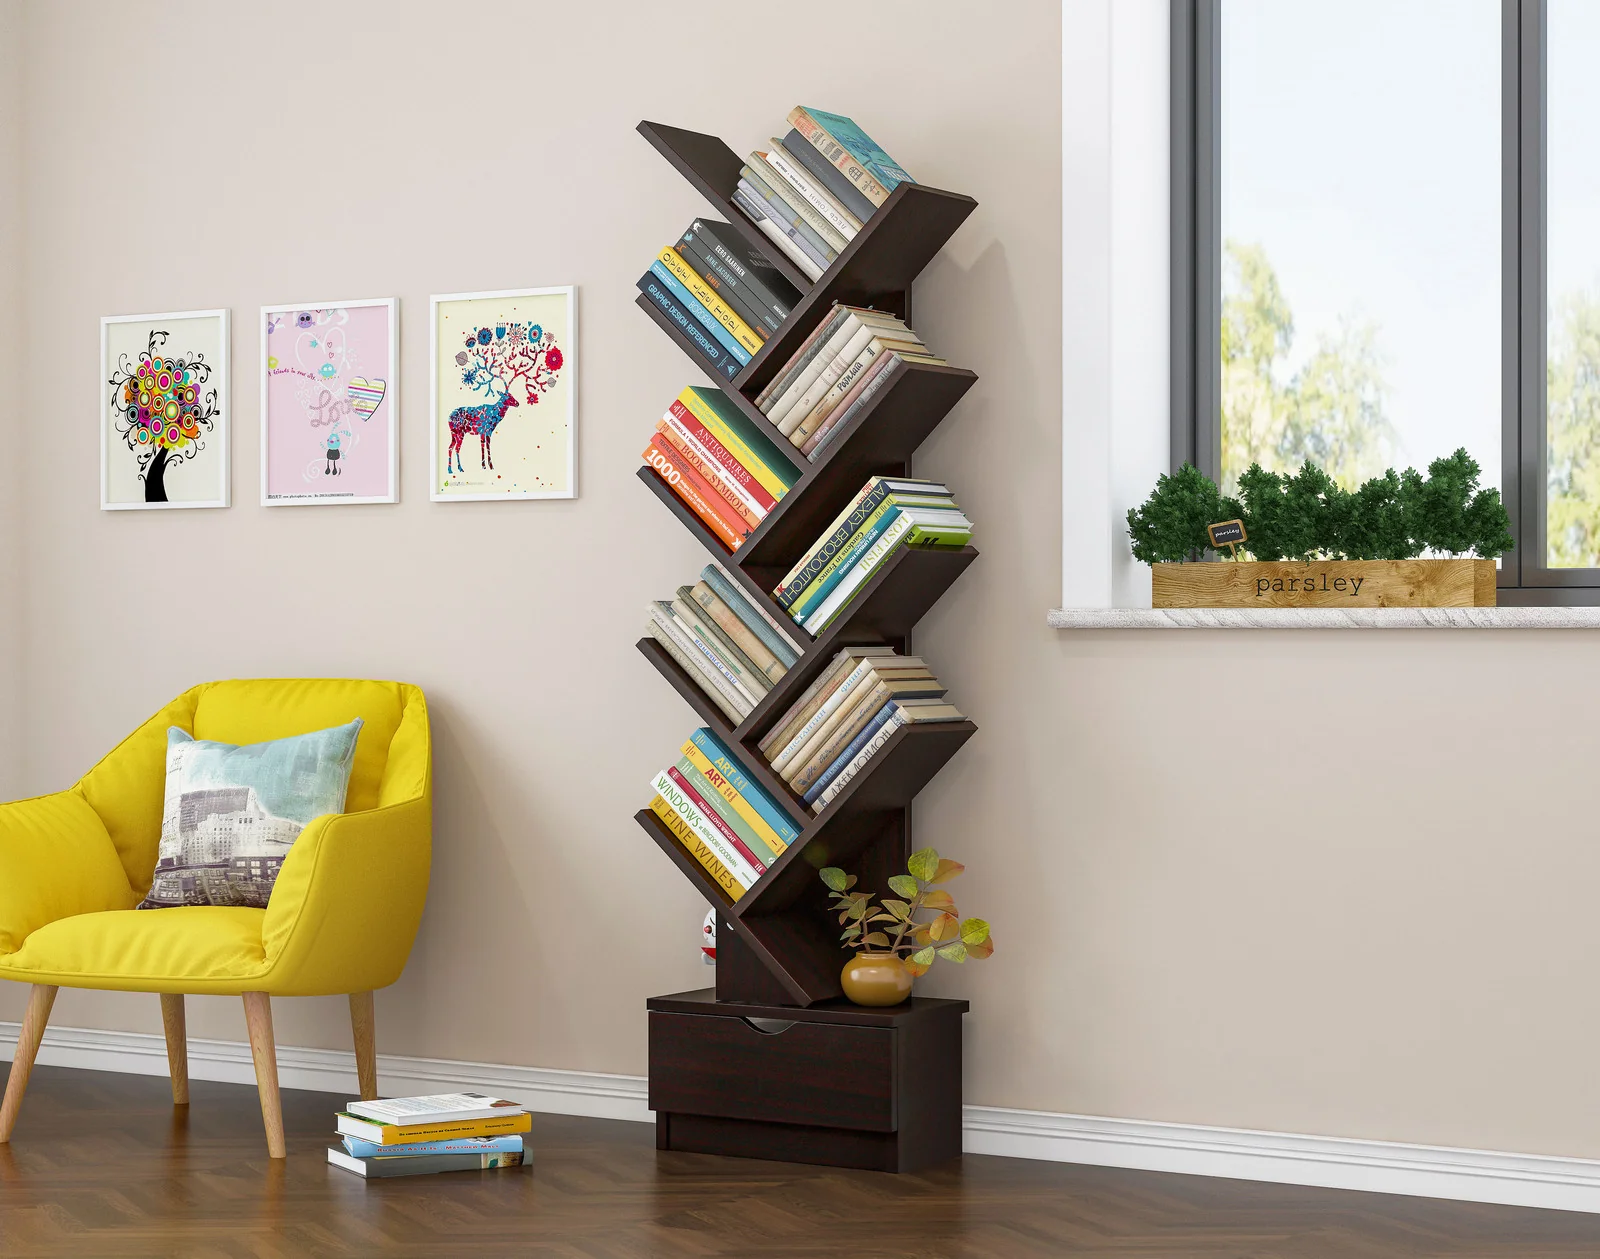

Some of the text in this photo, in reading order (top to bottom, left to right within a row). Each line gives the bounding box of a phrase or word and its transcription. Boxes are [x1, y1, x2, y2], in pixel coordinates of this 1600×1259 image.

[705, 254, 737, 287] ARNE JACOBSEN
[715, 245, 729, 260] EERO
[725, 255, 746, 277] SAARINEN
[705, 273, 721, 289] EAMES
[647, 284, 720, 359] GRAPHIC DESIGN REFERENCED
[687, 300, 718, 332] BORDEAUX
[309, 389, 368, 428] Love
[658, 438, 691, 473] TEXTILE DESIGNERS
[669, 418, 687, 438] FORMULA
[688, 437, 703, 453] WORLD
[700, 450, 722, 473] CHAMPIONS
[696, 428, 751, 484] ANTIQUAIRES
[646, 448, 681, 485] 1000
[672, 438, 682, 449] THE
[681, 445, 705, 471] BOOK
[708, 474, 750, 517] SYMBOLS
[848, 484, 885, 532] ALEXEY
[841, 531, 864, 558] Gardens
[878, 515, 909, 546] LOST
[1215, 529, 1240, 538] parsley
[784, 528, 849, 602] BRODOVITCH
[838, 529, 878, 574] NEW URBAN HOUSING
[857, 543, 885, 571] FISH
[818, 562, 837, 584] France
[1255, 574, 1364, 597] parsley
[724, 670, 737, 684] ЛЕВ
[781, 709, 827, 760] КОНСТАНТИН
[841, 667, 863, 693] ФИНН
[705, 768, 726, 788] ART
[715, 757, 736, 777] ART
[657, 776, 702, 828] WINDOWS
[701, 827, 721, 848] BERGDORF
[718, 844, 738, 868] GOODMAN
[698, 801, 737, 843] FRANK LLOYD WRIGHT
[663, 809, 695, 843] FINE
[695, 841, 737, 889] WINES
